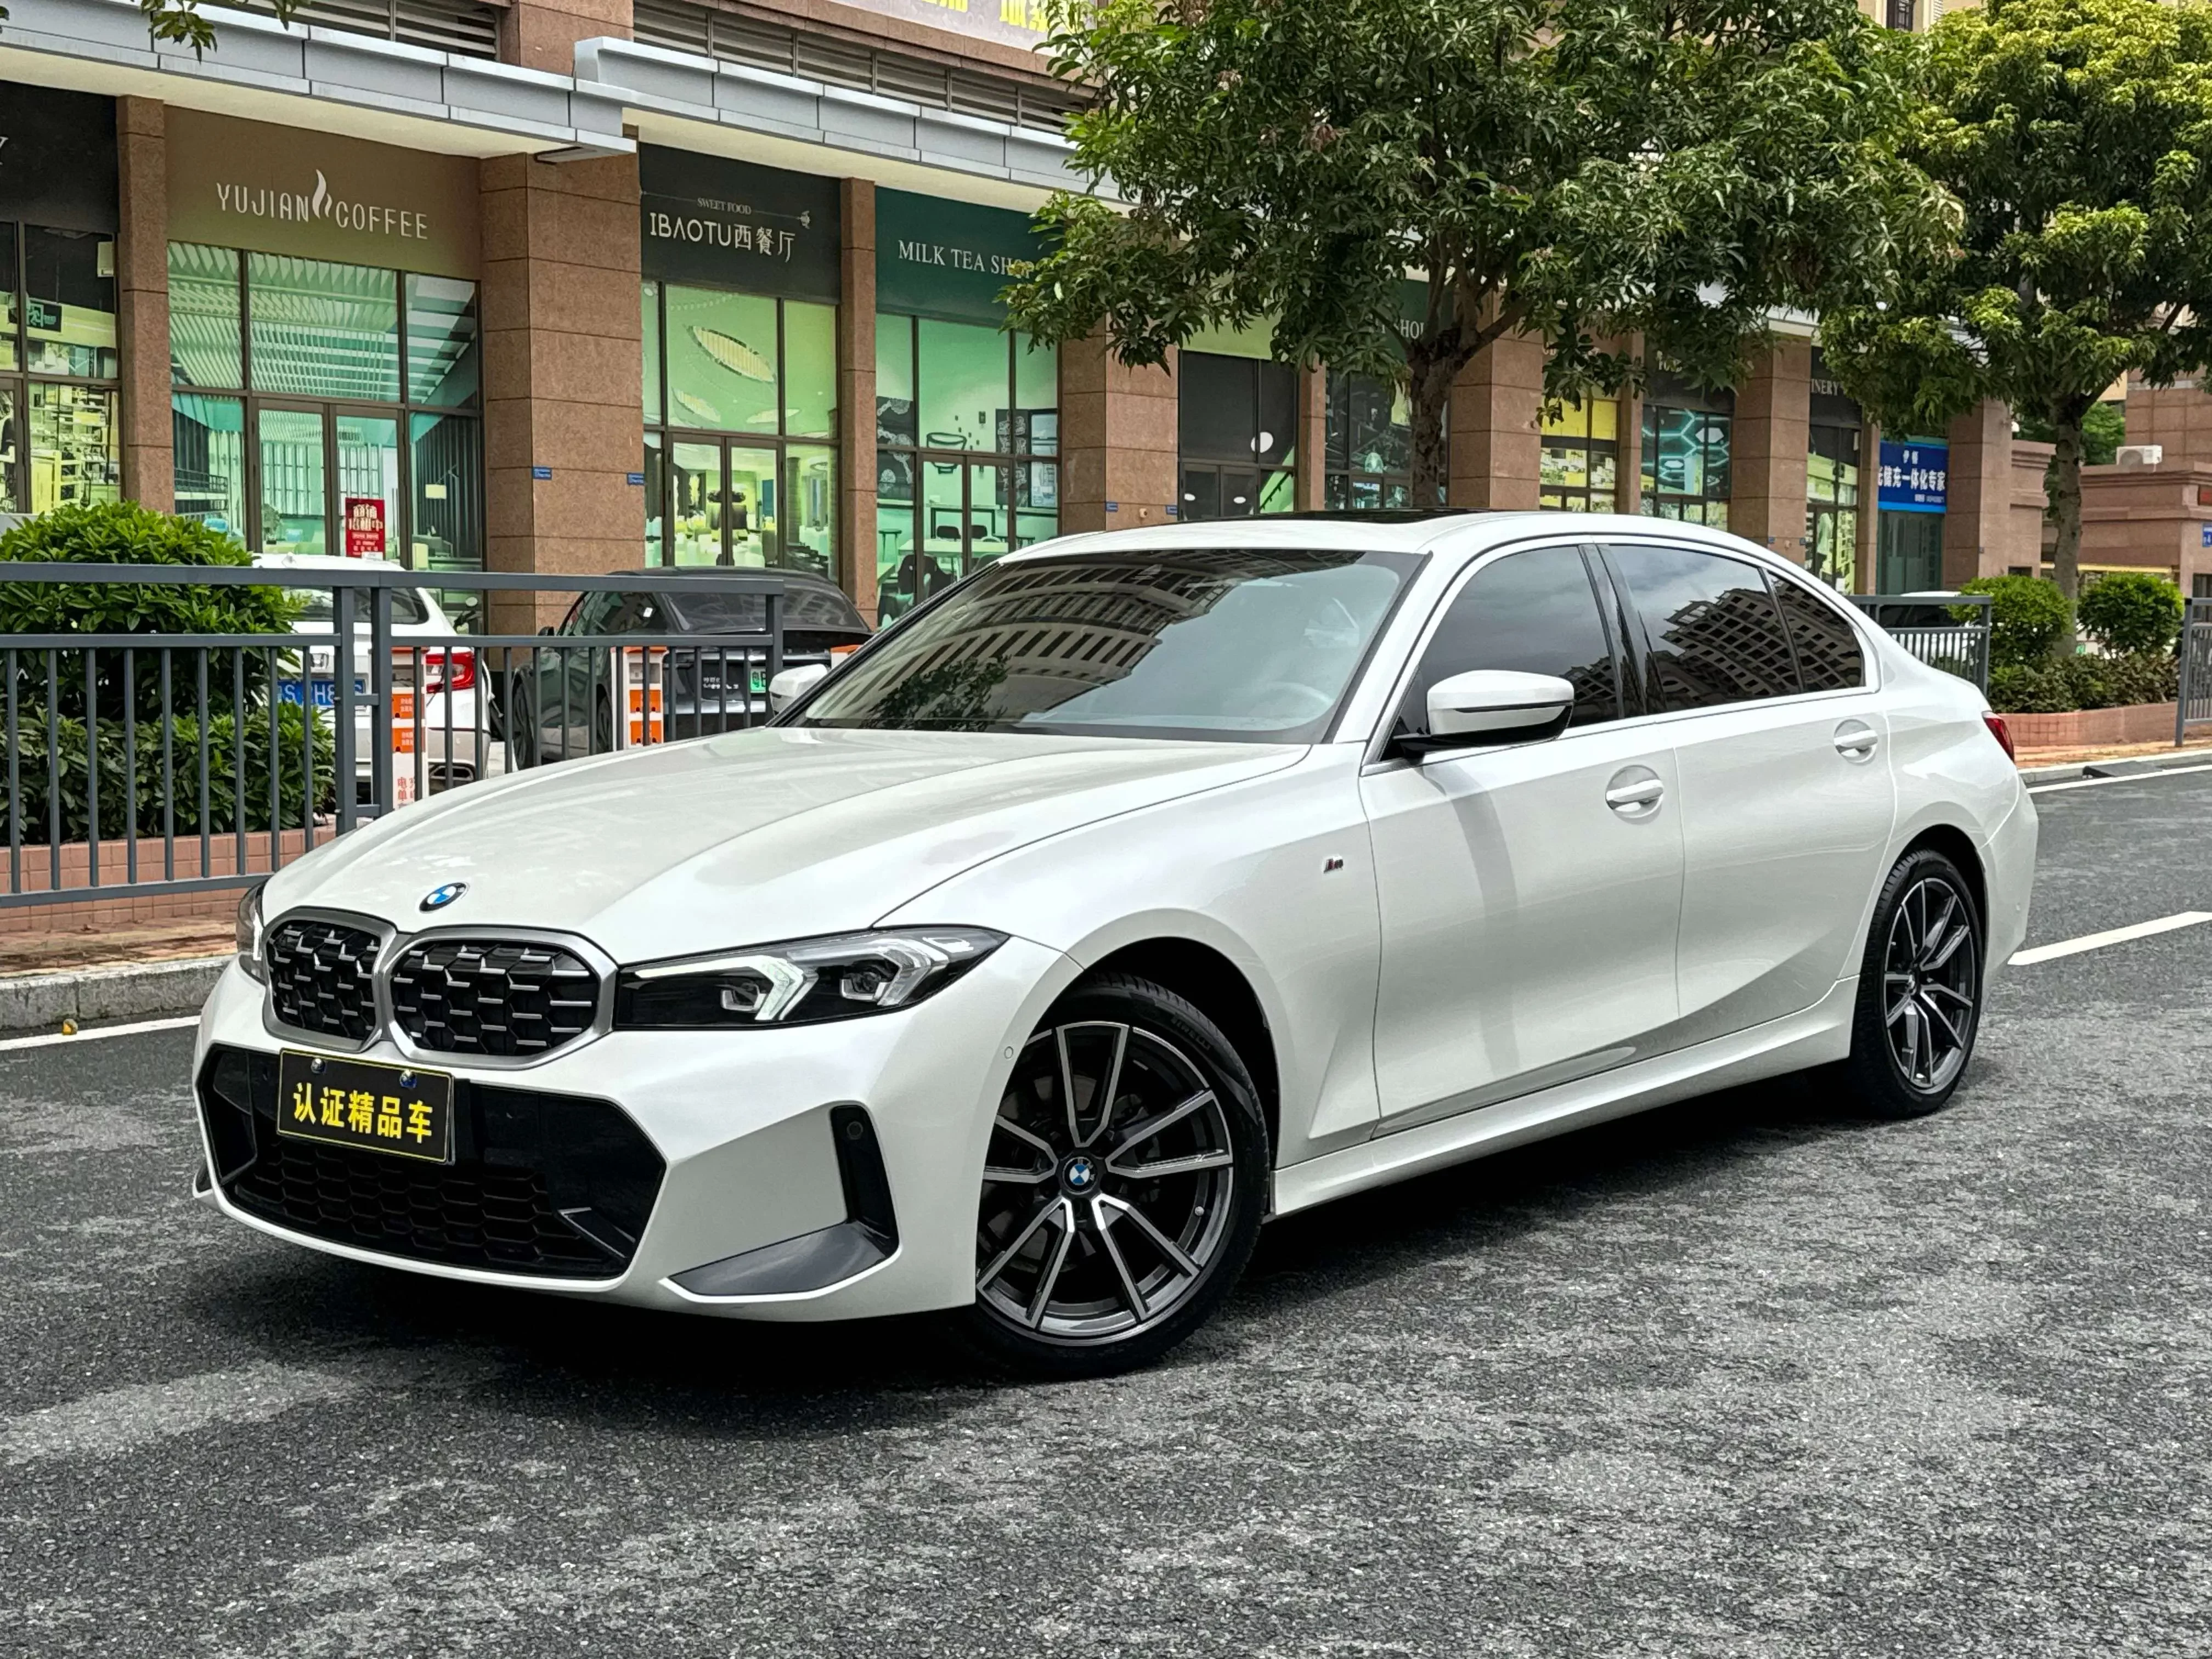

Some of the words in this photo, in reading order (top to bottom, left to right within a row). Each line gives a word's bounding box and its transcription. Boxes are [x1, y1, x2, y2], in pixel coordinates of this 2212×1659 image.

[217, 182, 308, 223] YUJIAN
[336, 201, 428, 239] COFFEE
[697, 197, 726, 211] SWEET
[727, 202, 752, 215] FOOD
[898, 240, 946, 266] MILK
[951, 249, 985, 272] TEA
[293, 1082, 433, 1144] 认证精品车
